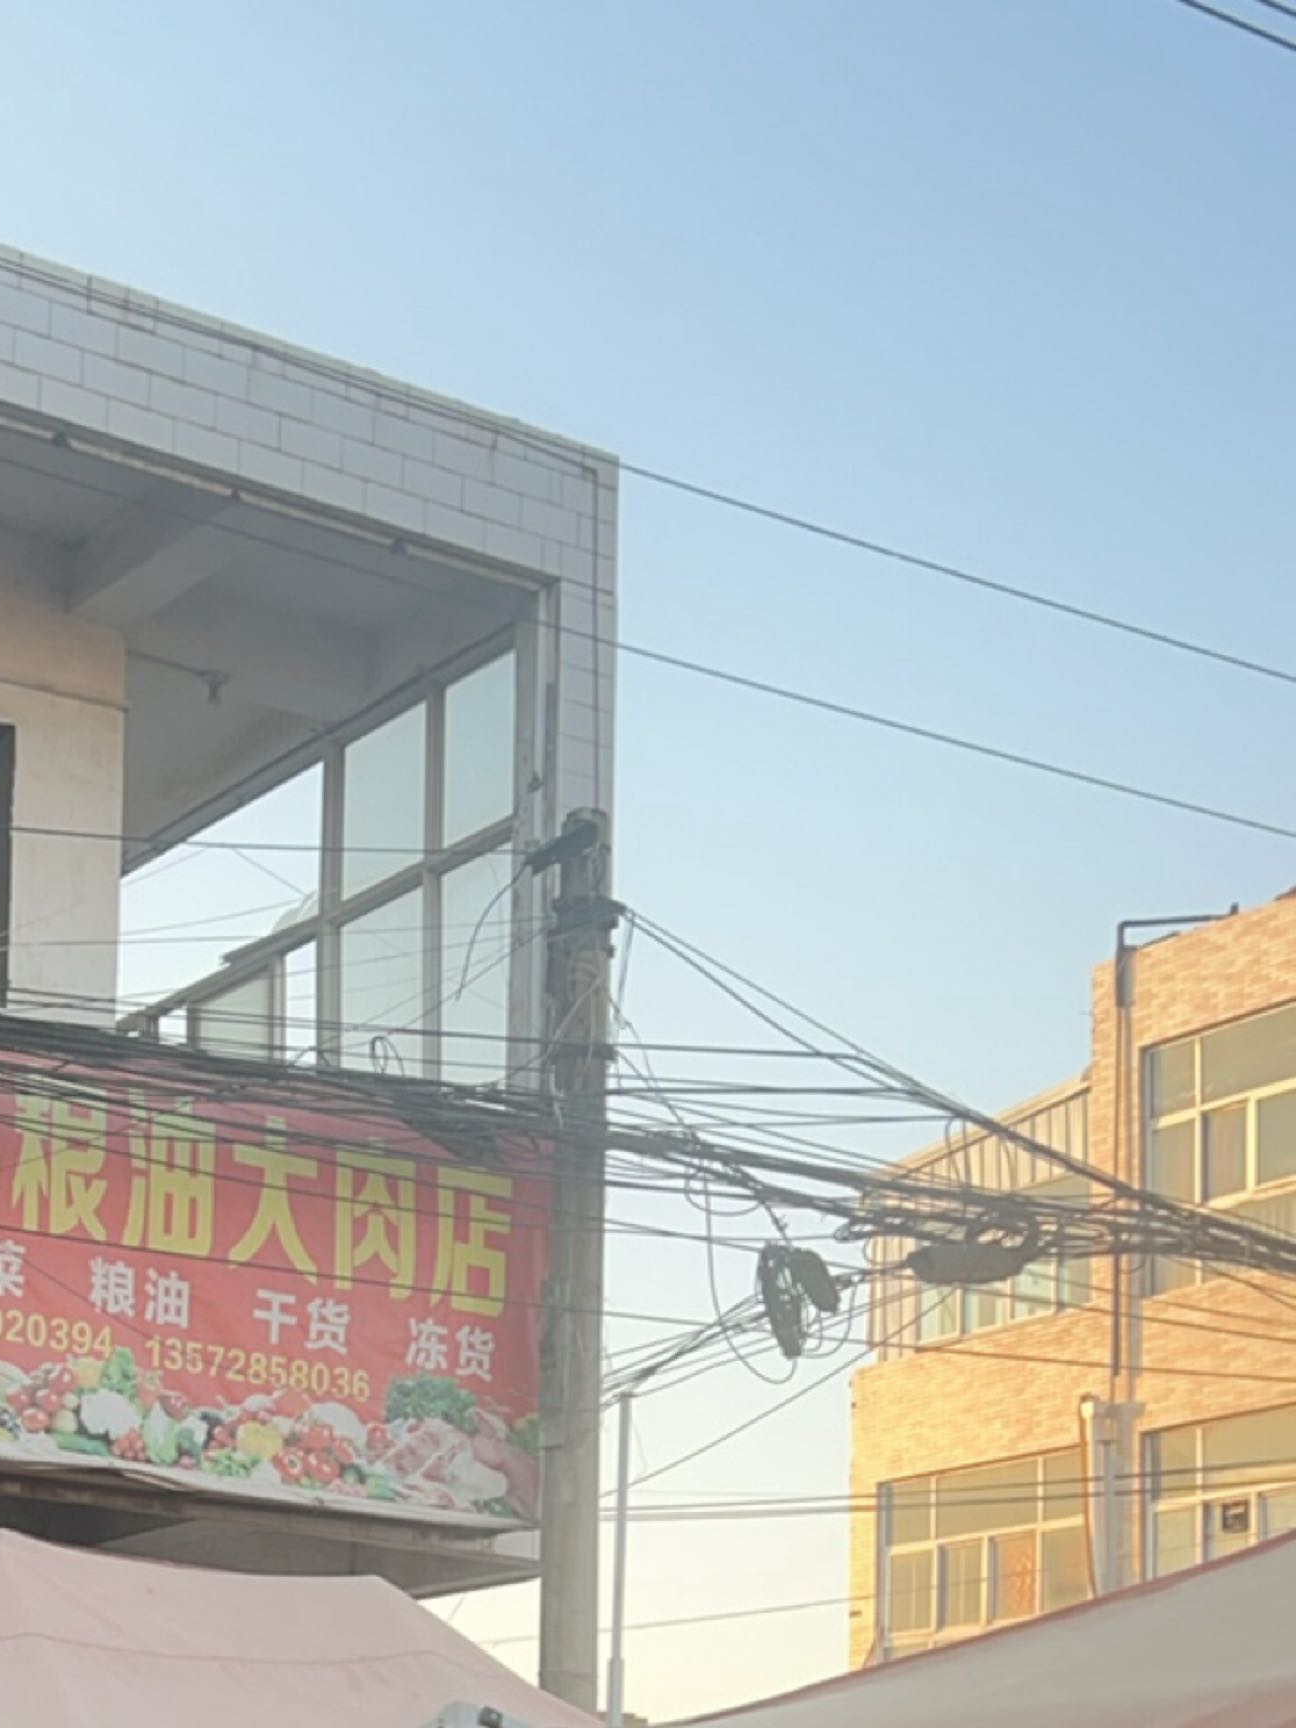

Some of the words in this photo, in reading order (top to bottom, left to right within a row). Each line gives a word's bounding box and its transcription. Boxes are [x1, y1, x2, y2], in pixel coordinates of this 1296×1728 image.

[89, 1257, 190, 1329] 粮油
[253, 1289, 350, 1355] 干货
[406, 1317, 496, 1383] 冻货
[145, 1337, 370, 1402] 13572858036
